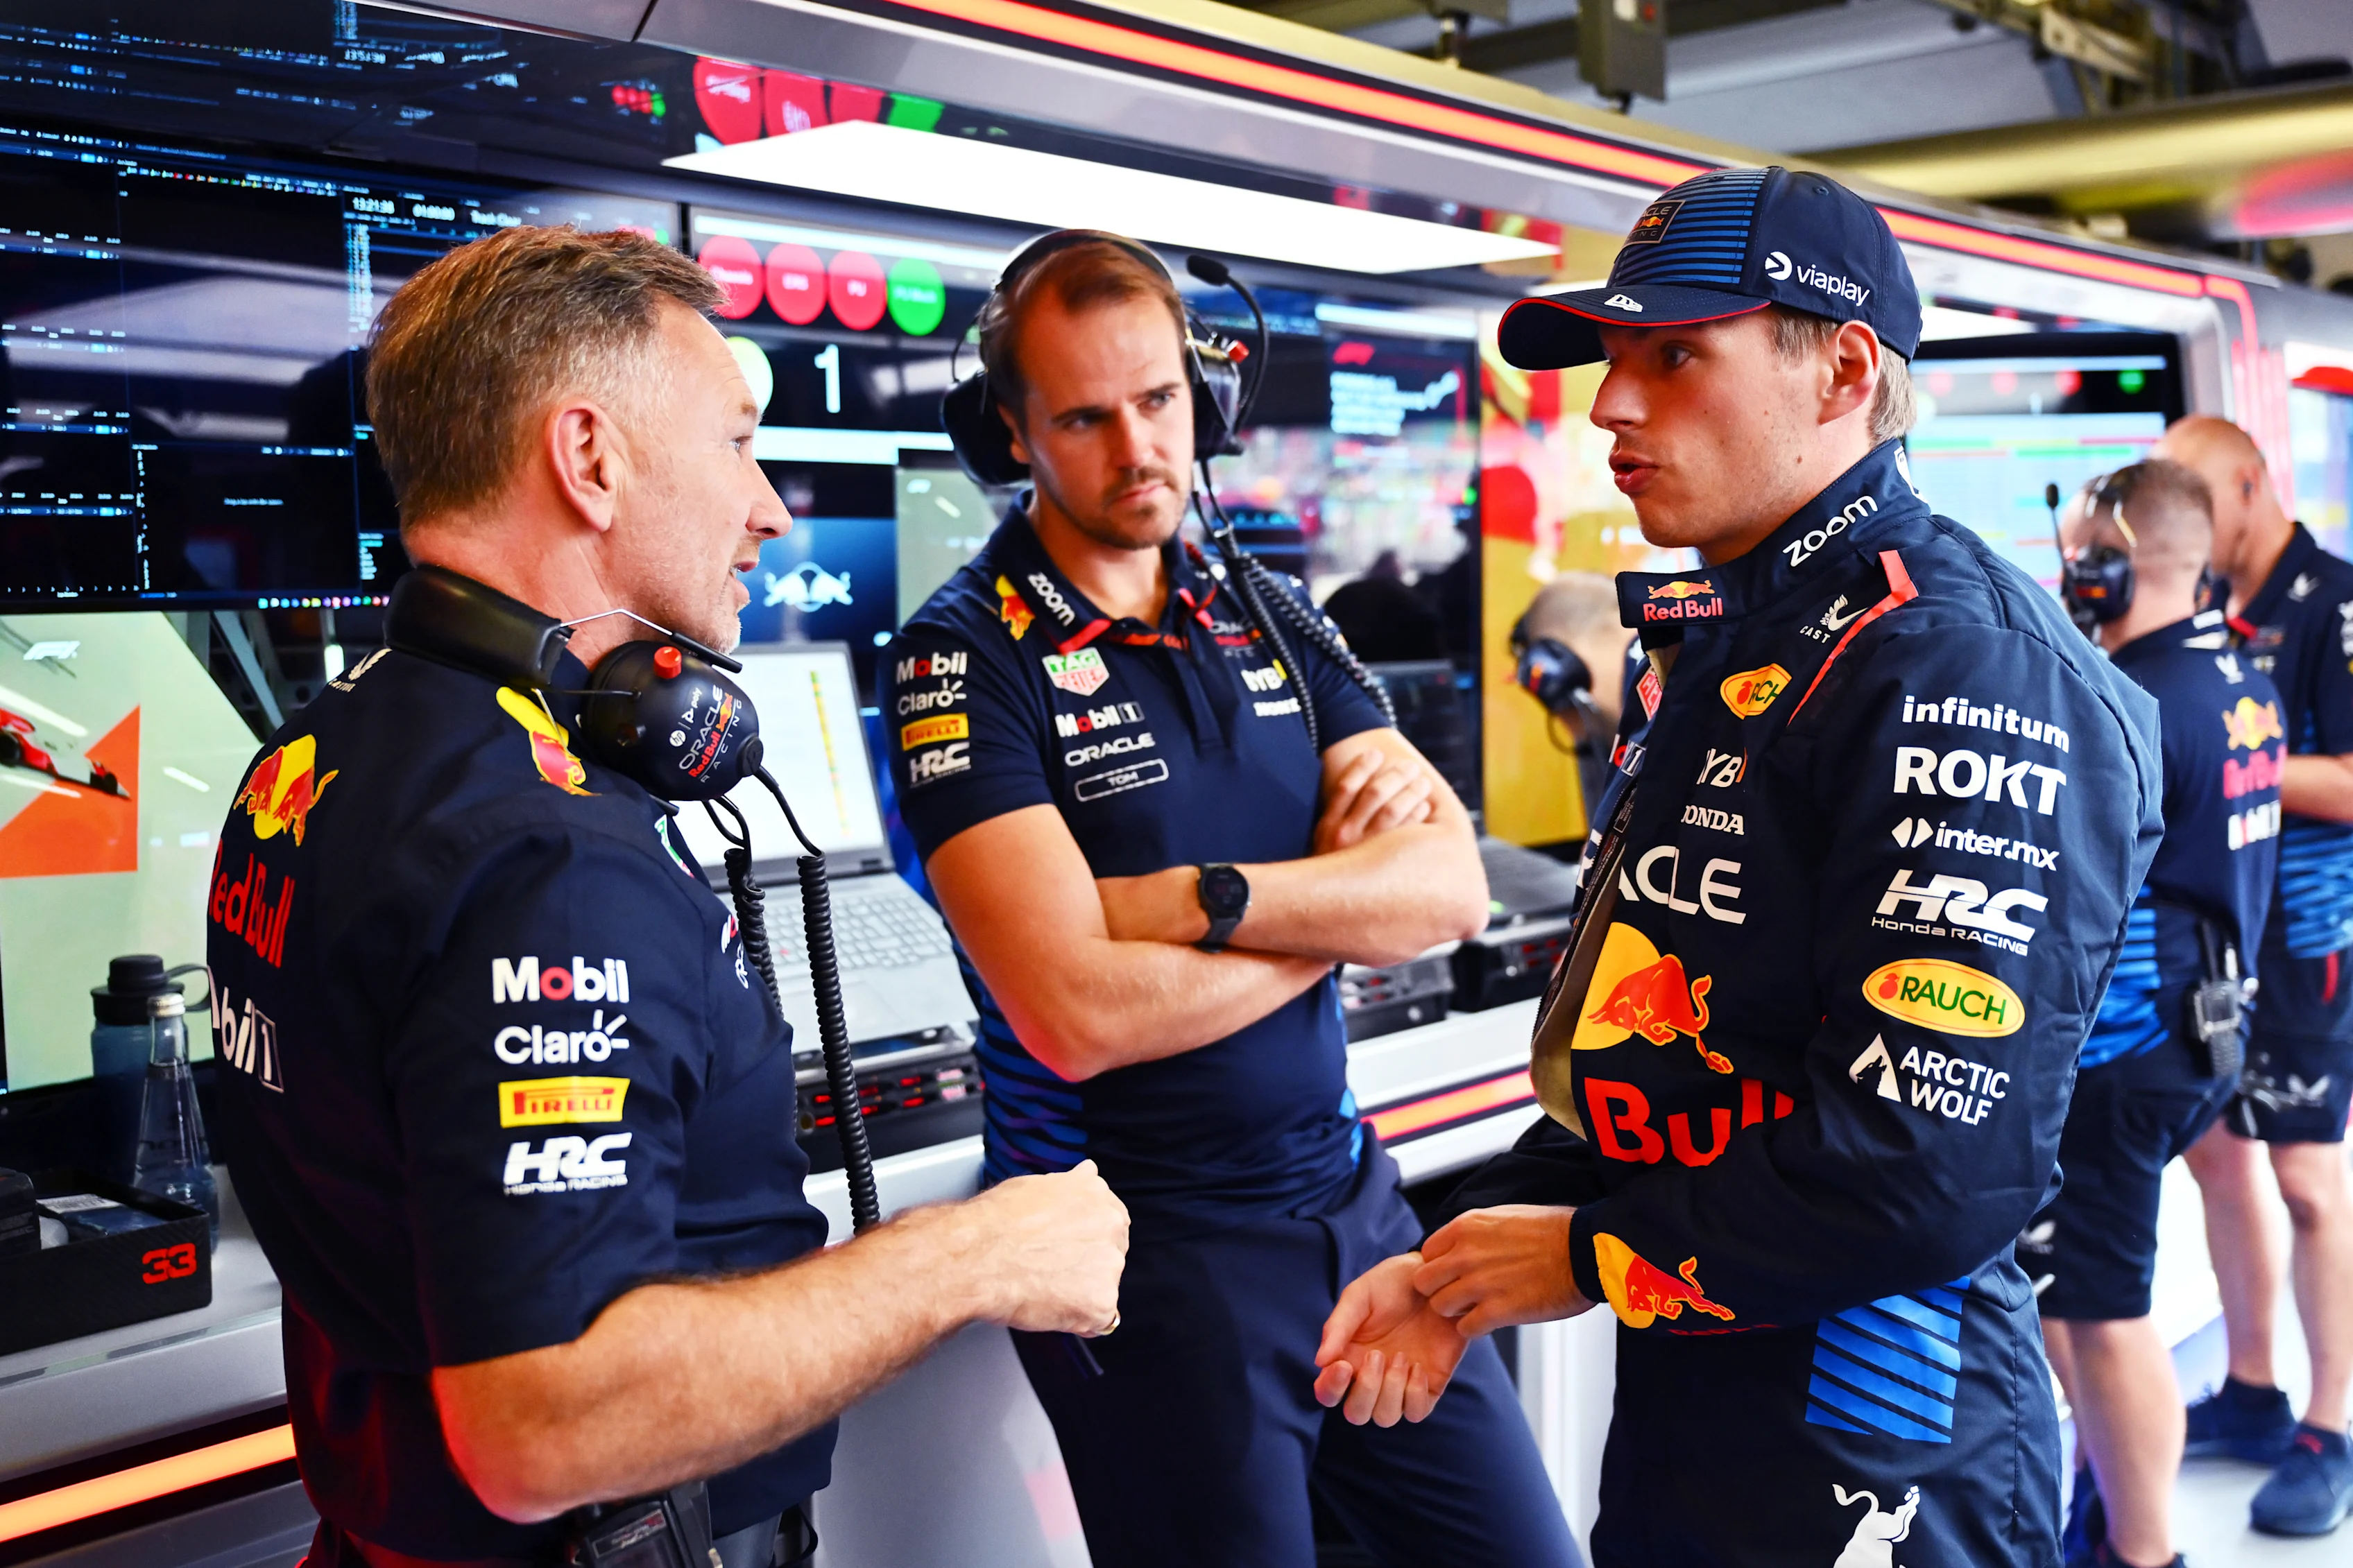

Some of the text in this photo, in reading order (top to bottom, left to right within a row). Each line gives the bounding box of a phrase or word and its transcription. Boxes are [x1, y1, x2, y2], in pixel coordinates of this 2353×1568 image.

[1797, 263, 1871, 307] viaplay
[814, 343, 841, 414] 1
[1782, 494, 1878, 567] zoom
[1027, 571, 1076, 626] zoom
[1643, 597, 1723, 622] Red Bull
[1799, 626, 1831, 644] CAST
[896, 652, 968, 684] Mobil
[691, 687, 702, 708] poly
[898, 685, 957, 716] Claro
[1054, 702, 1140, 738] Mobil 1
[679, 684, 723, 770] ORACLE
[701, 699, 742, 783] RACING
[1902, 695, 2069, 754] infinitum
[688, 731, 721, 777] Red Bull
[909, 742, 970, 784] HRC
[1065, 732, 1156, 767] ORACLE
[1107, 770, 1139, 786] TOM
[1893, 746, 2067, 816] ROKT
[1935, 820, 2060, 871] inter.mx
[1618, 845, 1746, 924] CLE
[1876, 869, 2048, 942] HRC
[246, 862, 295, 968] Bull
[1871, 916, 2028, 956] Honda RACING
[492, 956, 629, 1003] Mobil
[1900, 976, 2007, 1025] RAUCH
[494, 1017, 617, 1065] Claro
[1899, 1046, 2010, 1099] ARCTIC
[513, 1087, 615, 1116] PIRELLI
[1911, 1079, 1993, 1126] WOLF
[503, 1132, 633, 1185] HRC
[142, 1241, 197, 1284] 33
